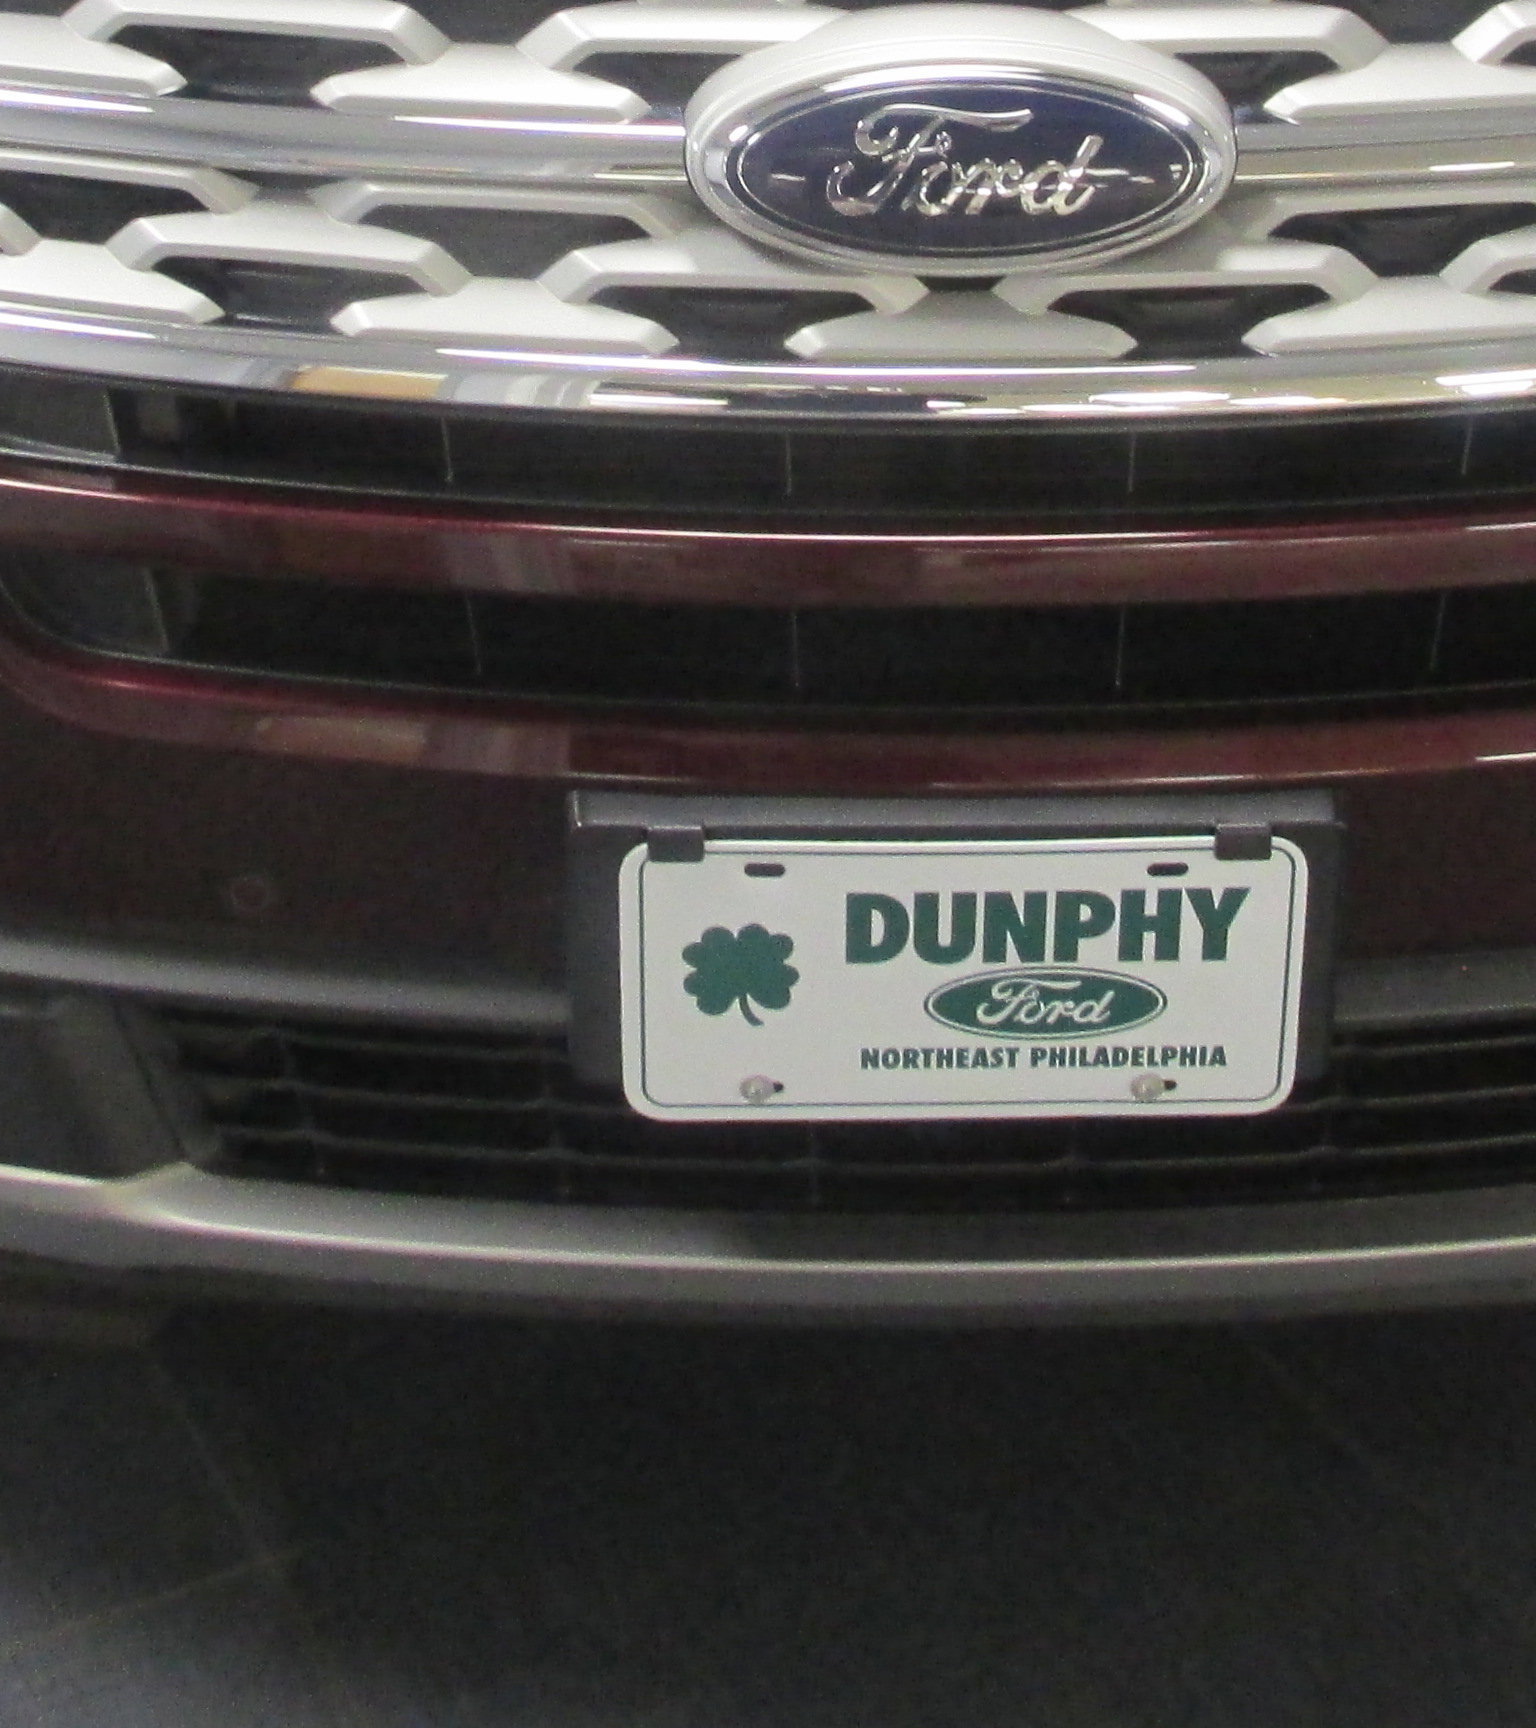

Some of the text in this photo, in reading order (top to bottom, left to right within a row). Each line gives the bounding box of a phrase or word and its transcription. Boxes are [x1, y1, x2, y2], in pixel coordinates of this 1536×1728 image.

[825, 103, 1104, 217] Ford
[845, 887, 1251, 965] DUNPHY
[976, 978, 1114, 1025] Ford
[860, 1045, 1227, 1069] NORTHEAST PHILADELPHIA
